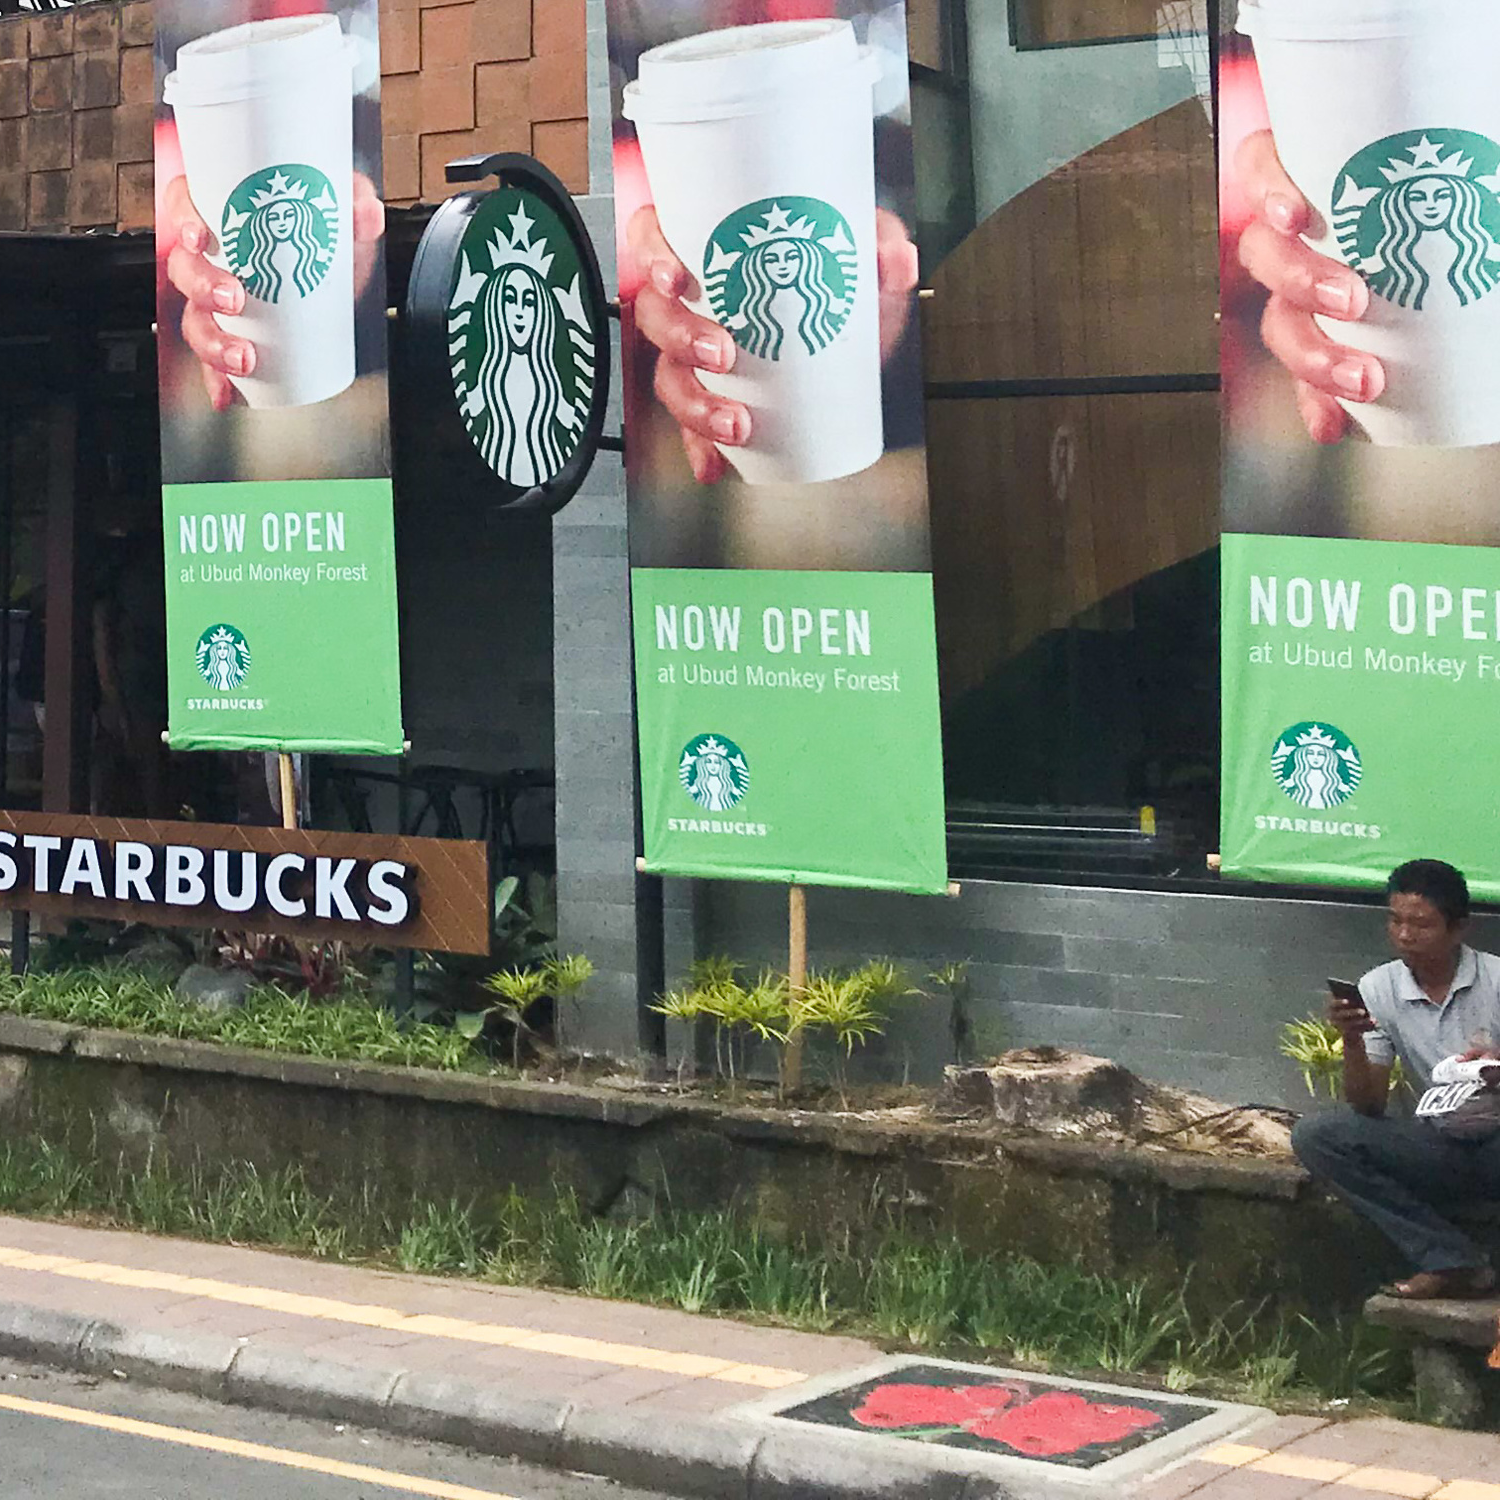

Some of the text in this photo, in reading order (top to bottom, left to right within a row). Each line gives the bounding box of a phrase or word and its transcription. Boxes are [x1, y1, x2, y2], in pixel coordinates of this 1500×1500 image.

[180, 512, 346, 553] NOW OPEN
[180, 562, 368, 586] at Ubud Monkey Forest
[1250, 575, 1500, 642] NOW OPE
[655, 604, 872, 656] NOW OPEN
[1249, 642, 1273, 664] at
[1283, 642, 1353, 669] Ubud
[1365, 647, 1468, 682] Monkey
[657, 663, 901, 693] at Ubud Monkey Forest
[187, 697, 265, 710] STARBUCKS
[667, 817, 768, 837] STARBUCKS
[1254, 815, 1382, 839] STARBUCKS
